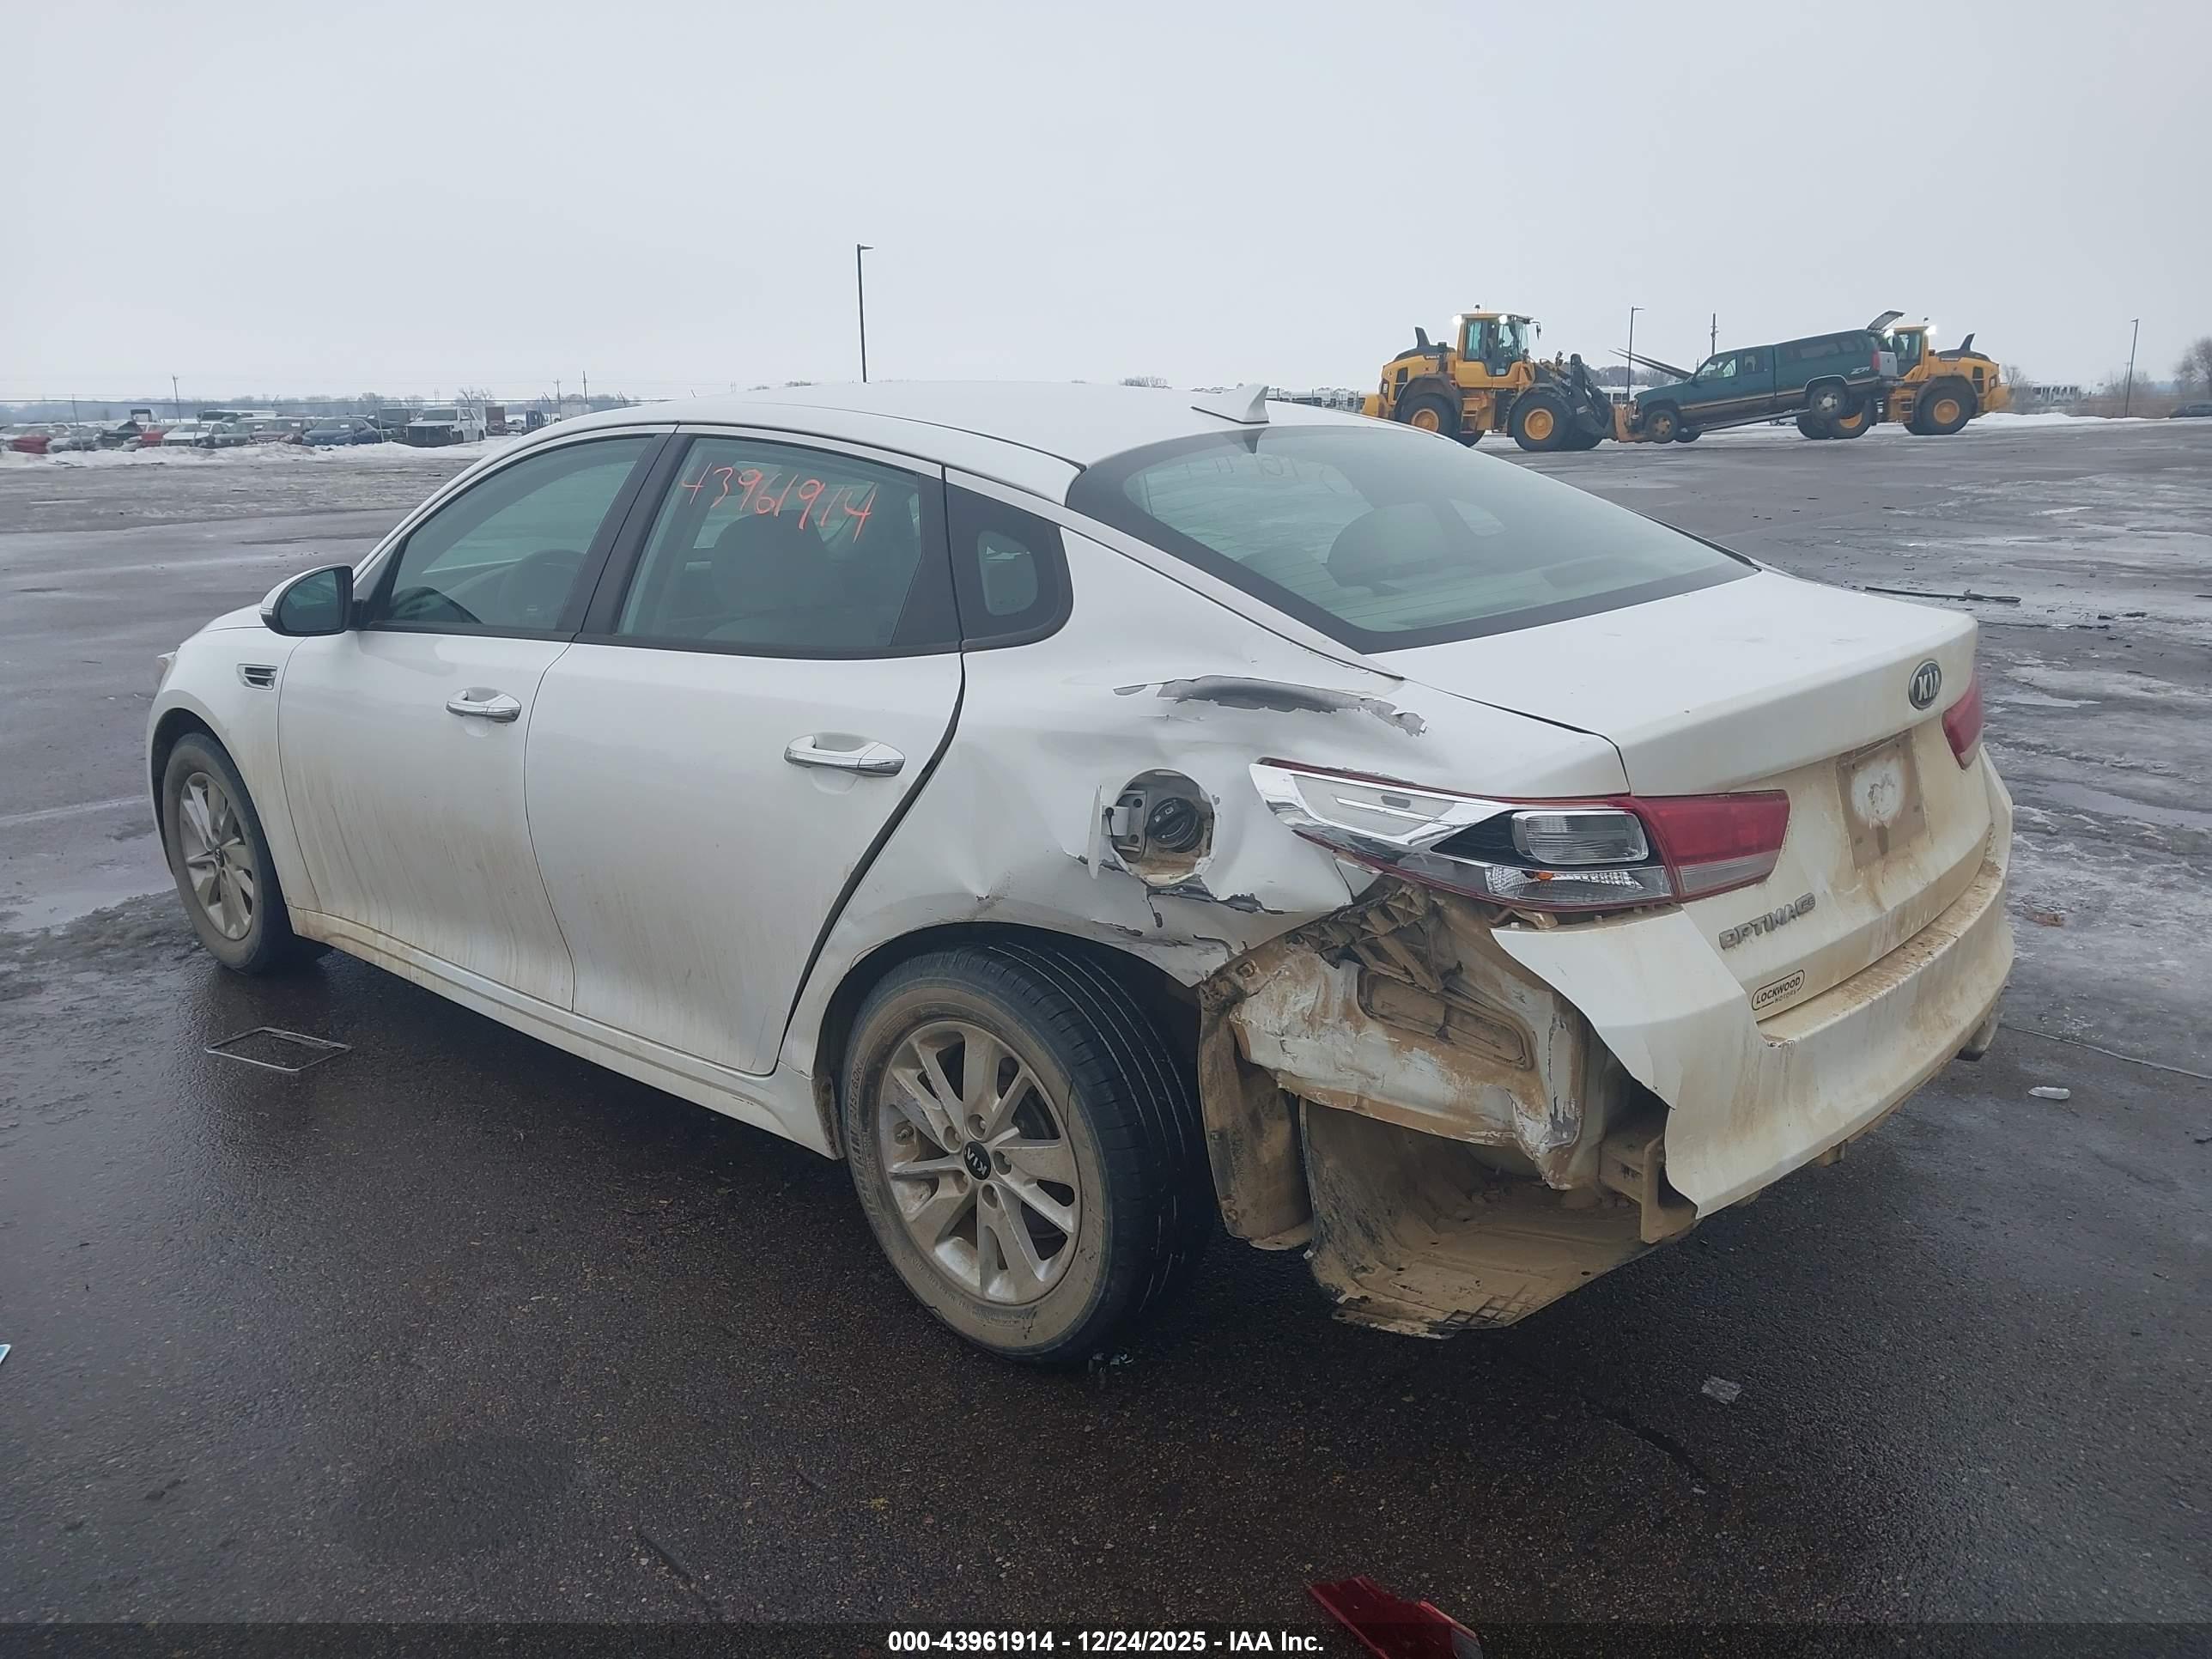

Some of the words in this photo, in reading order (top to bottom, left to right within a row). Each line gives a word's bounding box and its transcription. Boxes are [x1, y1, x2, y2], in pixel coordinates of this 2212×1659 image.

[681, 461, 878, 543] 43961914
[1718, 903, 1797, 950] OPTIMA
[1756, 976, 1801, 1005] LOCKWOOD
